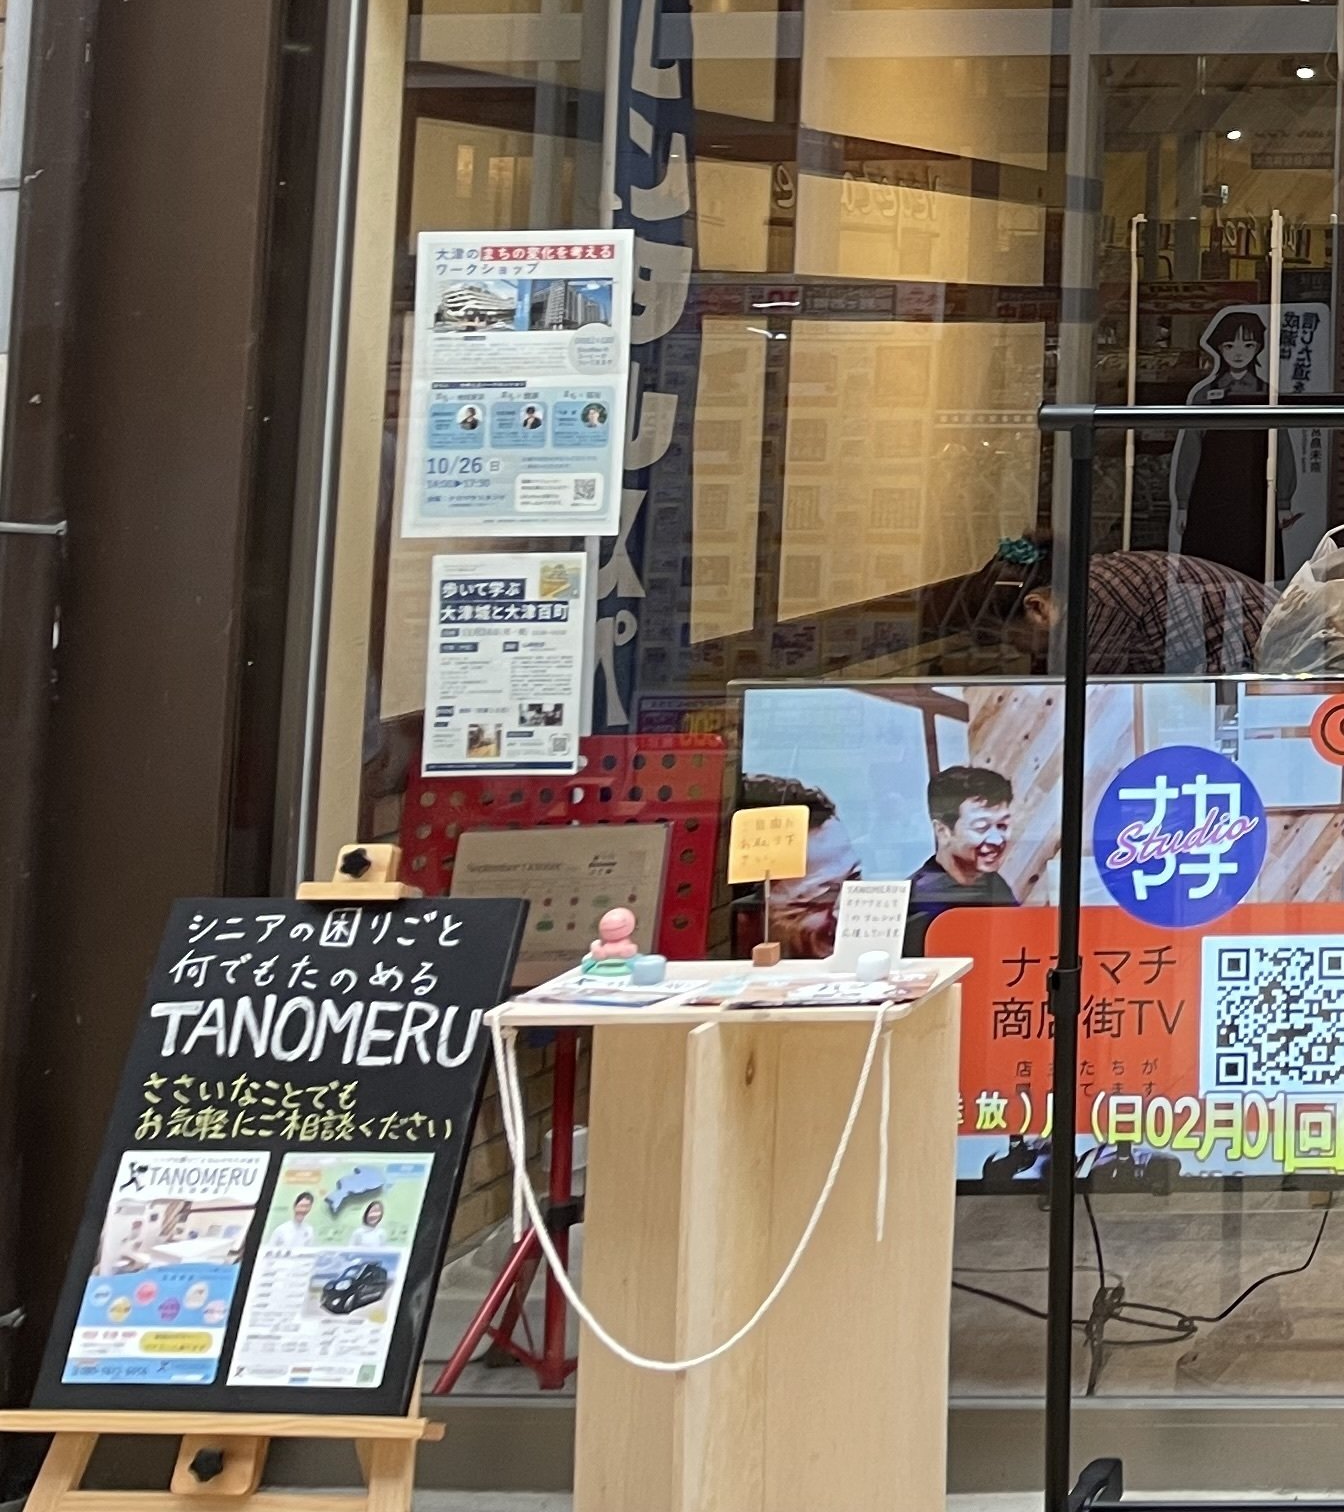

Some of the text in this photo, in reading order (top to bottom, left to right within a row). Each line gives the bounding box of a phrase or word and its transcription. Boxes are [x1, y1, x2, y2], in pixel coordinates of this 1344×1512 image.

[435, 262, 540, 275] ワークショップ
[426, 457, 483, 474] 10/26
[1107, 811, 1258, 870] Studio
[187, 907, 465, 949] シニアの困りごと
[169, 951, 439, 995] 何でもたのめる
[1002, 945, 1177, 988] ナマチ
[150, 993, 485, 1068] TANOMERU
[141, 1072, 360, 1109] ささいなことでも
[134, 1108, 453, 1142] お気軽にご相談ください
[149, 1166, 258, 1187] TANOMERU
